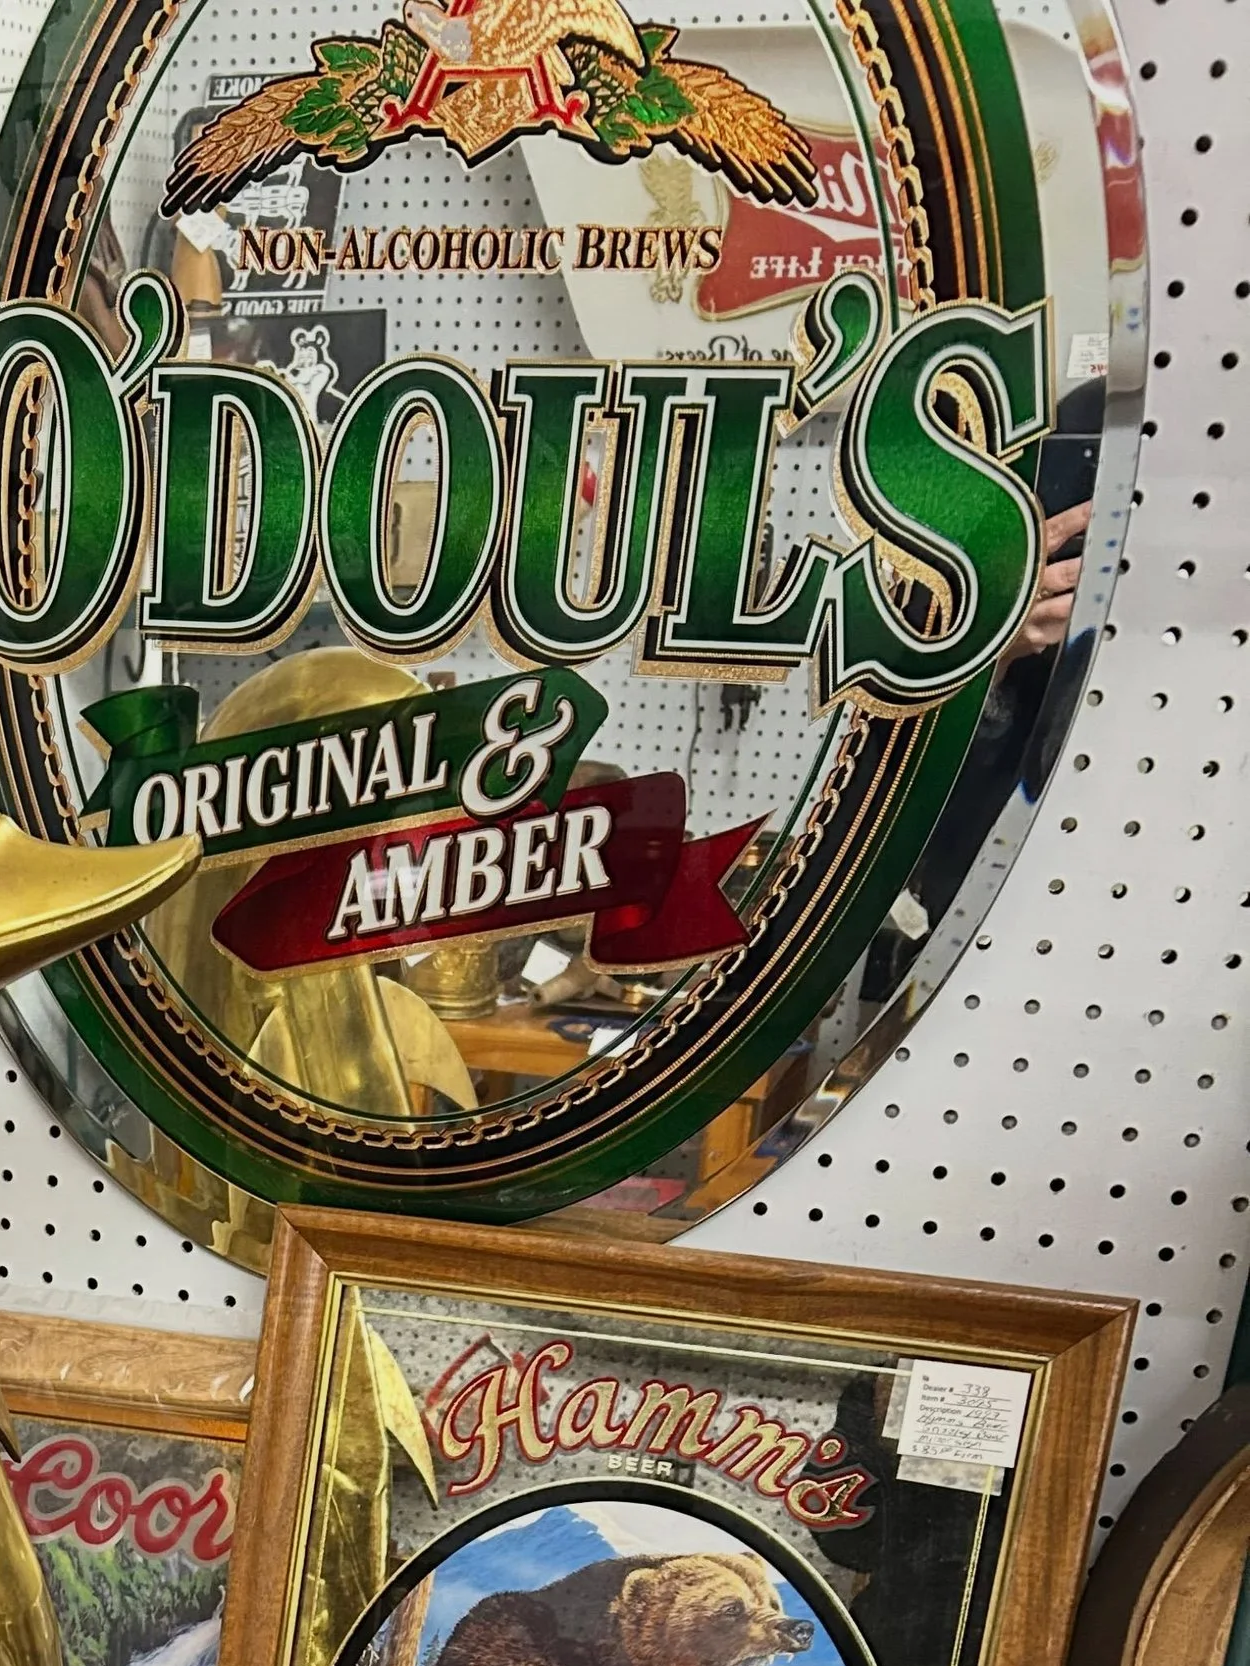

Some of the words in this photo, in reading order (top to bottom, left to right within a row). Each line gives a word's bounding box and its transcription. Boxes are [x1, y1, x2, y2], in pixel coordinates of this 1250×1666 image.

[238, 226, 565, 272] NON-ALCOHOLIC
[573, 223, 723, 272] BREWS
[131, 711, 452, 848] ORIGINAL
[457, 672, 573, 818] &
[325, 803, 611, 944] AMBER
[919, 1404, 962, 1414] Description
[921, 1394, 940, 1402] Item
[922, 1384, 948, 1392] Dealer
[962, 1383, 991, 1398] 338
[439, 1340, 867, 1528] Hamm's
[606, 1453, 673, 1477] BEER
[3, 1439, 235, 1562] Coor
